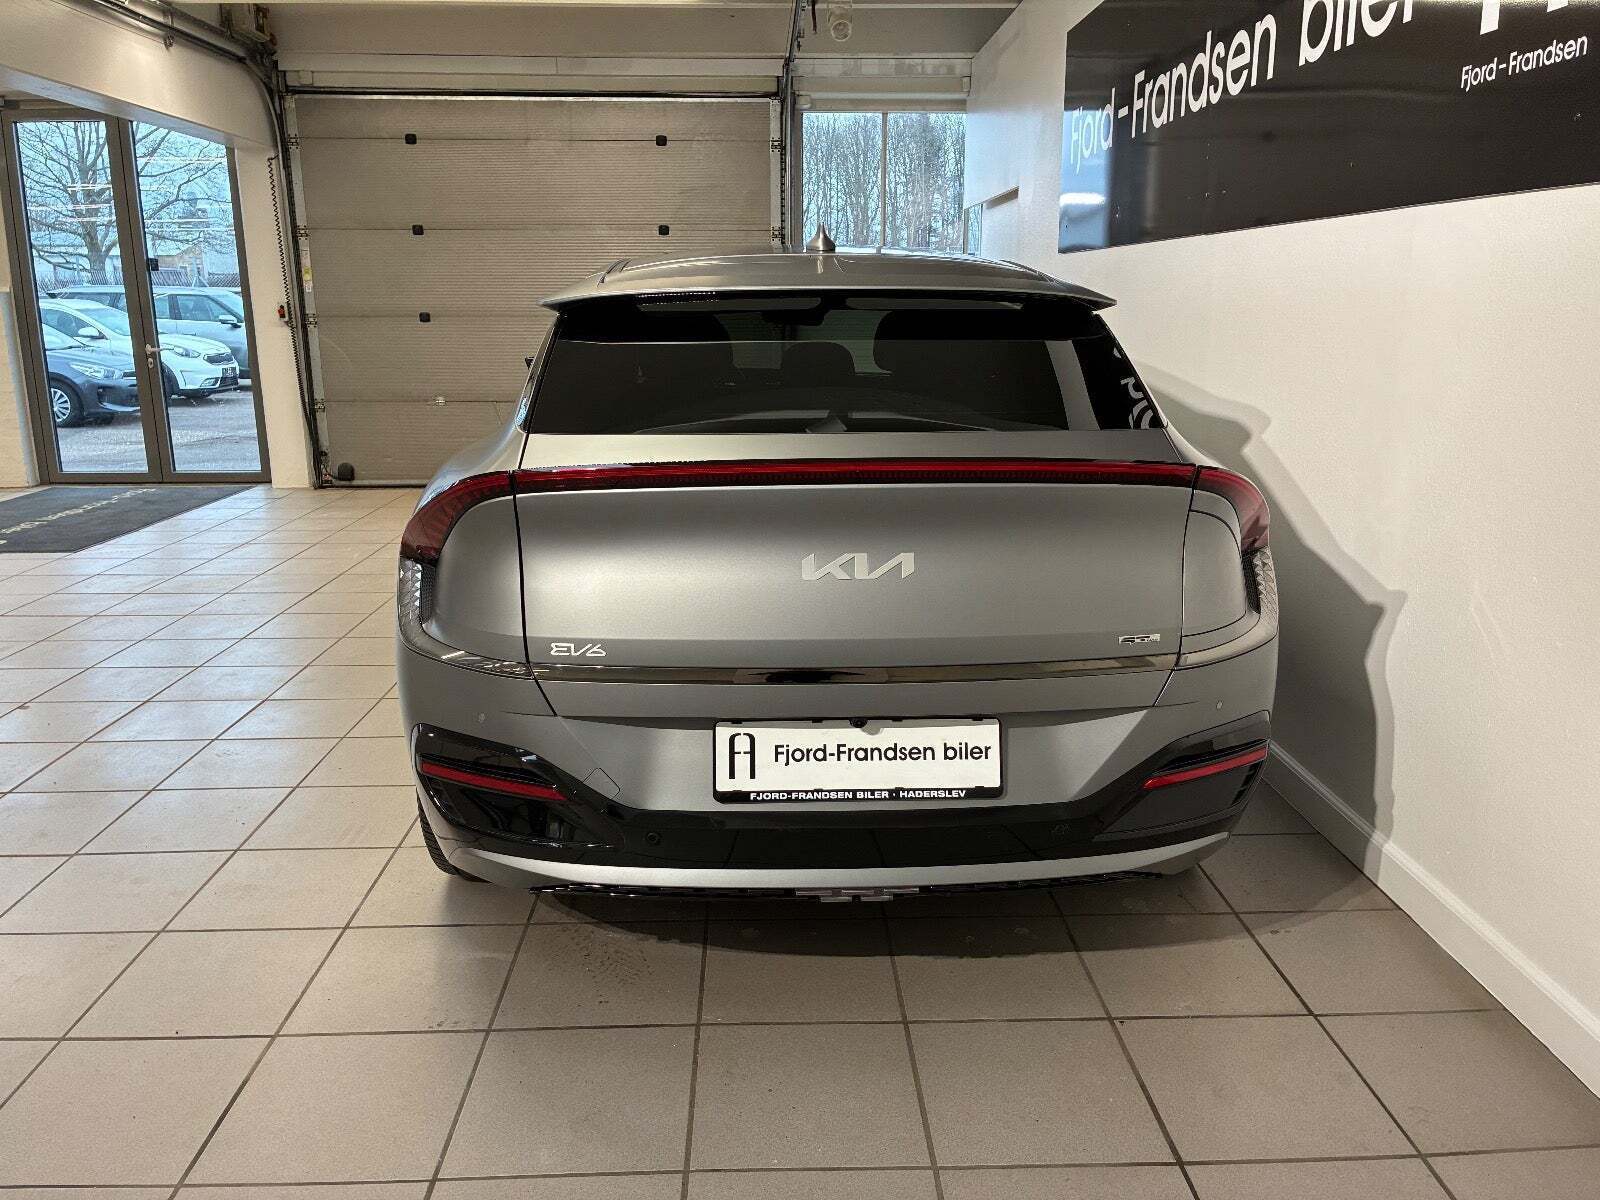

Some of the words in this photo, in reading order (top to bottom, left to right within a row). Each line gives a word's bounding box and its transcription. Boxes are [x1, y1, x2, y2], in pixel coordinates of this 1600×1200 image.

[1461, 36, 1588, 92] Fjord-Frandsen
[1070, 13, 1277, 175] Fjord-Frandsen
[802, 553, 915, 580] KIA
[550, 642, 607, 657] EV6
[774, 744, 936, 767] Fjord-Frandsen
[943, 742, 992, 761] biler
[750, 791, 853, 801] FJORD-FRANDSEN
[856, 791, 889, 799] BILER
[899, 790, 966, 798] HADERSLEV
